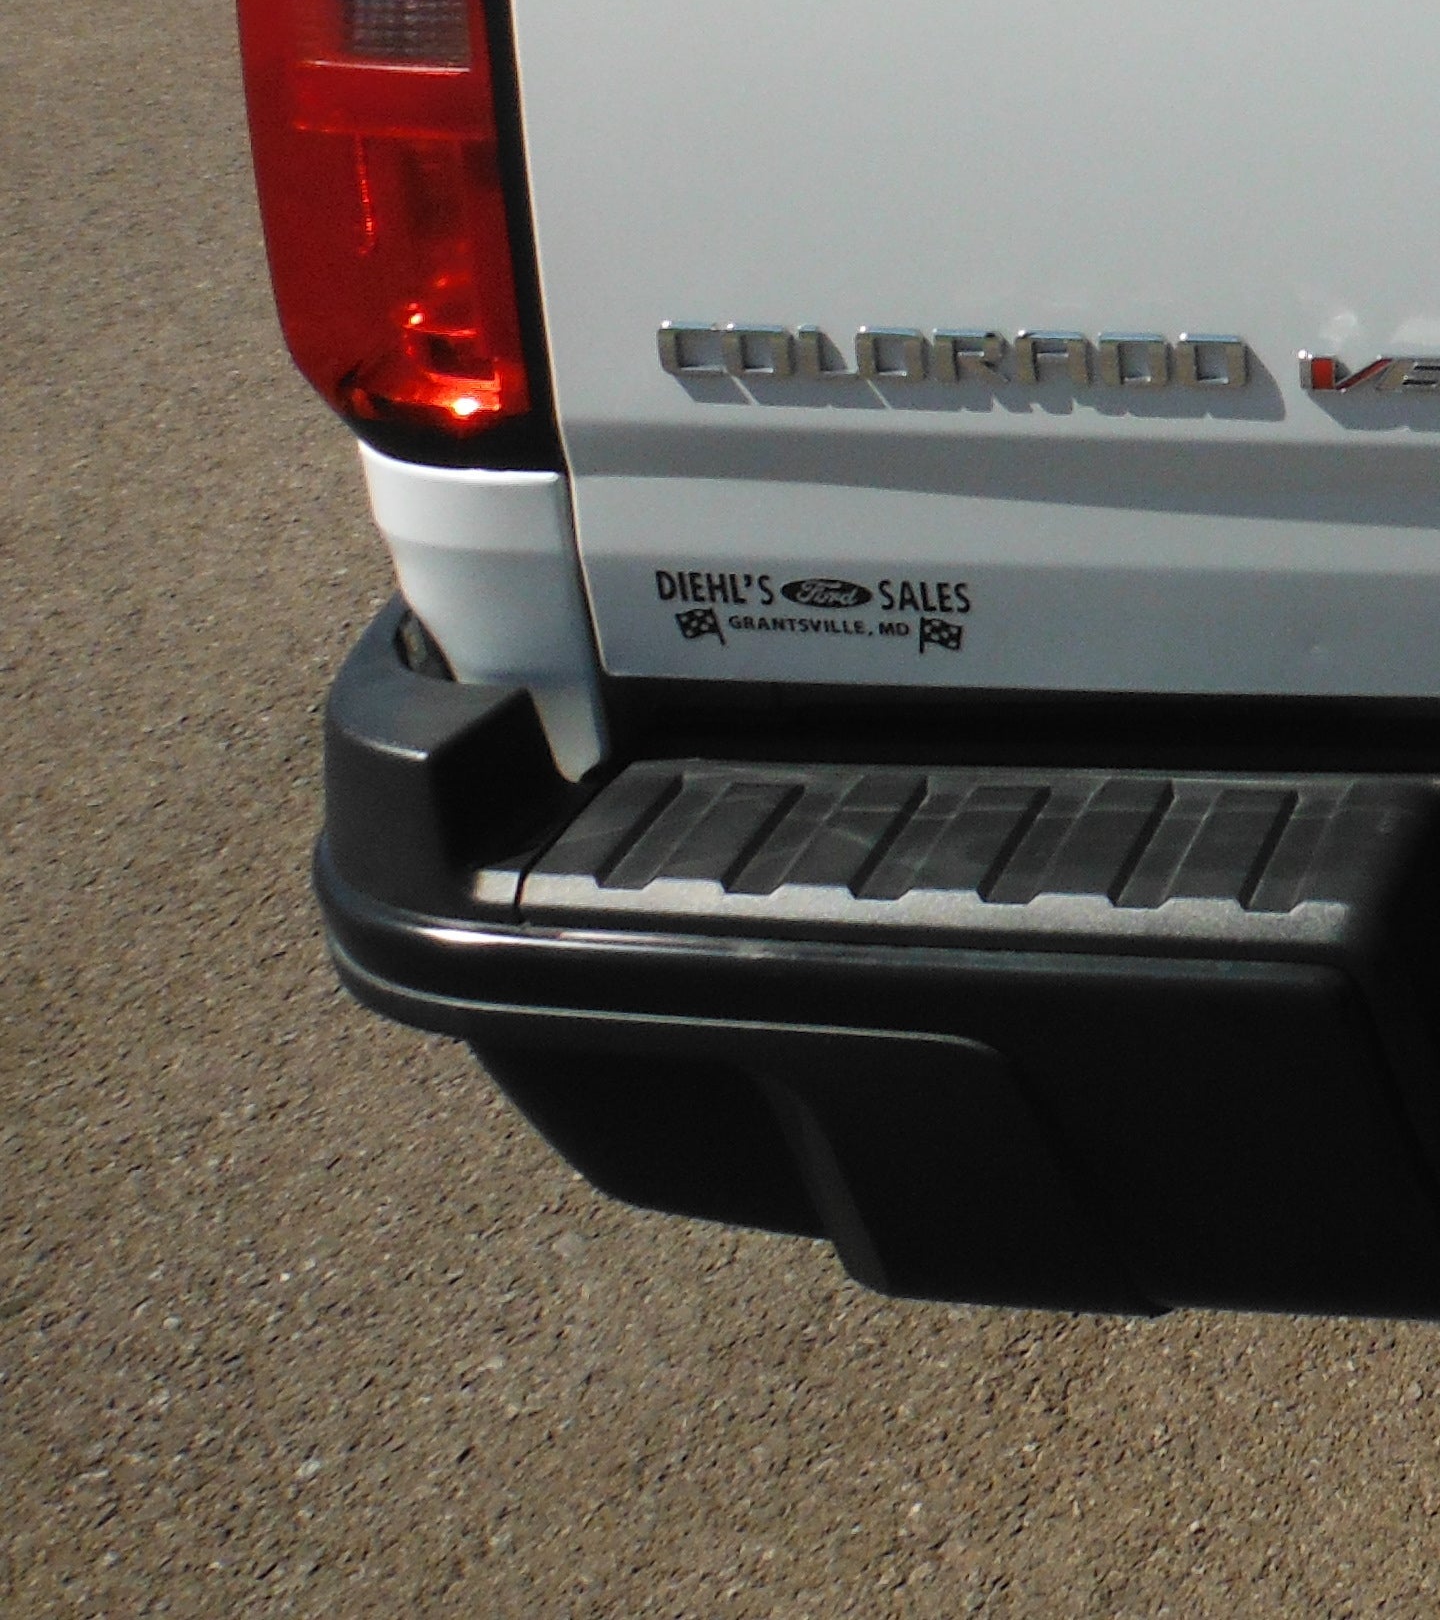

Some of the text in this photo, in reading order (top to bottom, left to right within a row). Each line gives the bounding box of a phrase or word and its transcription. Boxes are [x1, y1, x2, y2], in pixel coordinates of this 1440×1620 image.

[656, 319, 1249, 388] COLORADO
[655, 570, 971, 613] DIEHL'S Ford SALES
[727, 614, 911, 637] GRANTSVILLE, MD
